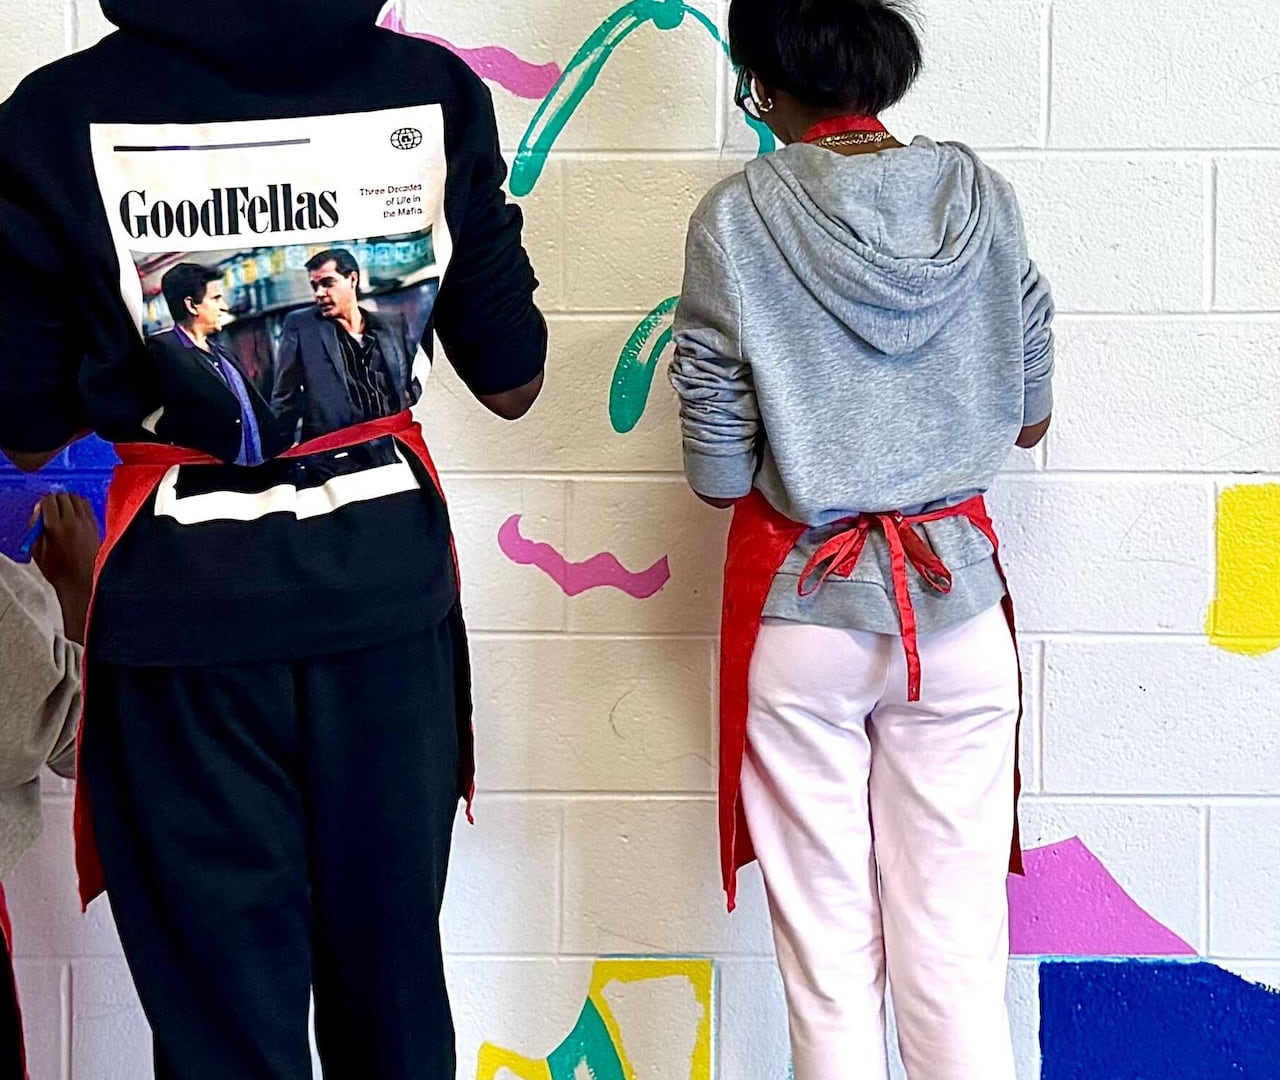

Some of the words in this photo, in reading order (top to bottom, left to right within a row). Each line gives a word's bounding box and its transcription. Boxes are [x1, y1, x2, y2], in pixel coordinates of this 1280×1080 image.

[360, 188, 385, 197] Three
[387, 184, 422, 195] Decades
[386, 197, 395, 206] of
[397, 196, 411, 205] Life
[413, 194, 421, 202] in
[120, 183, 340, 239] GoodFellas
[383, 209, 396, 218] the
